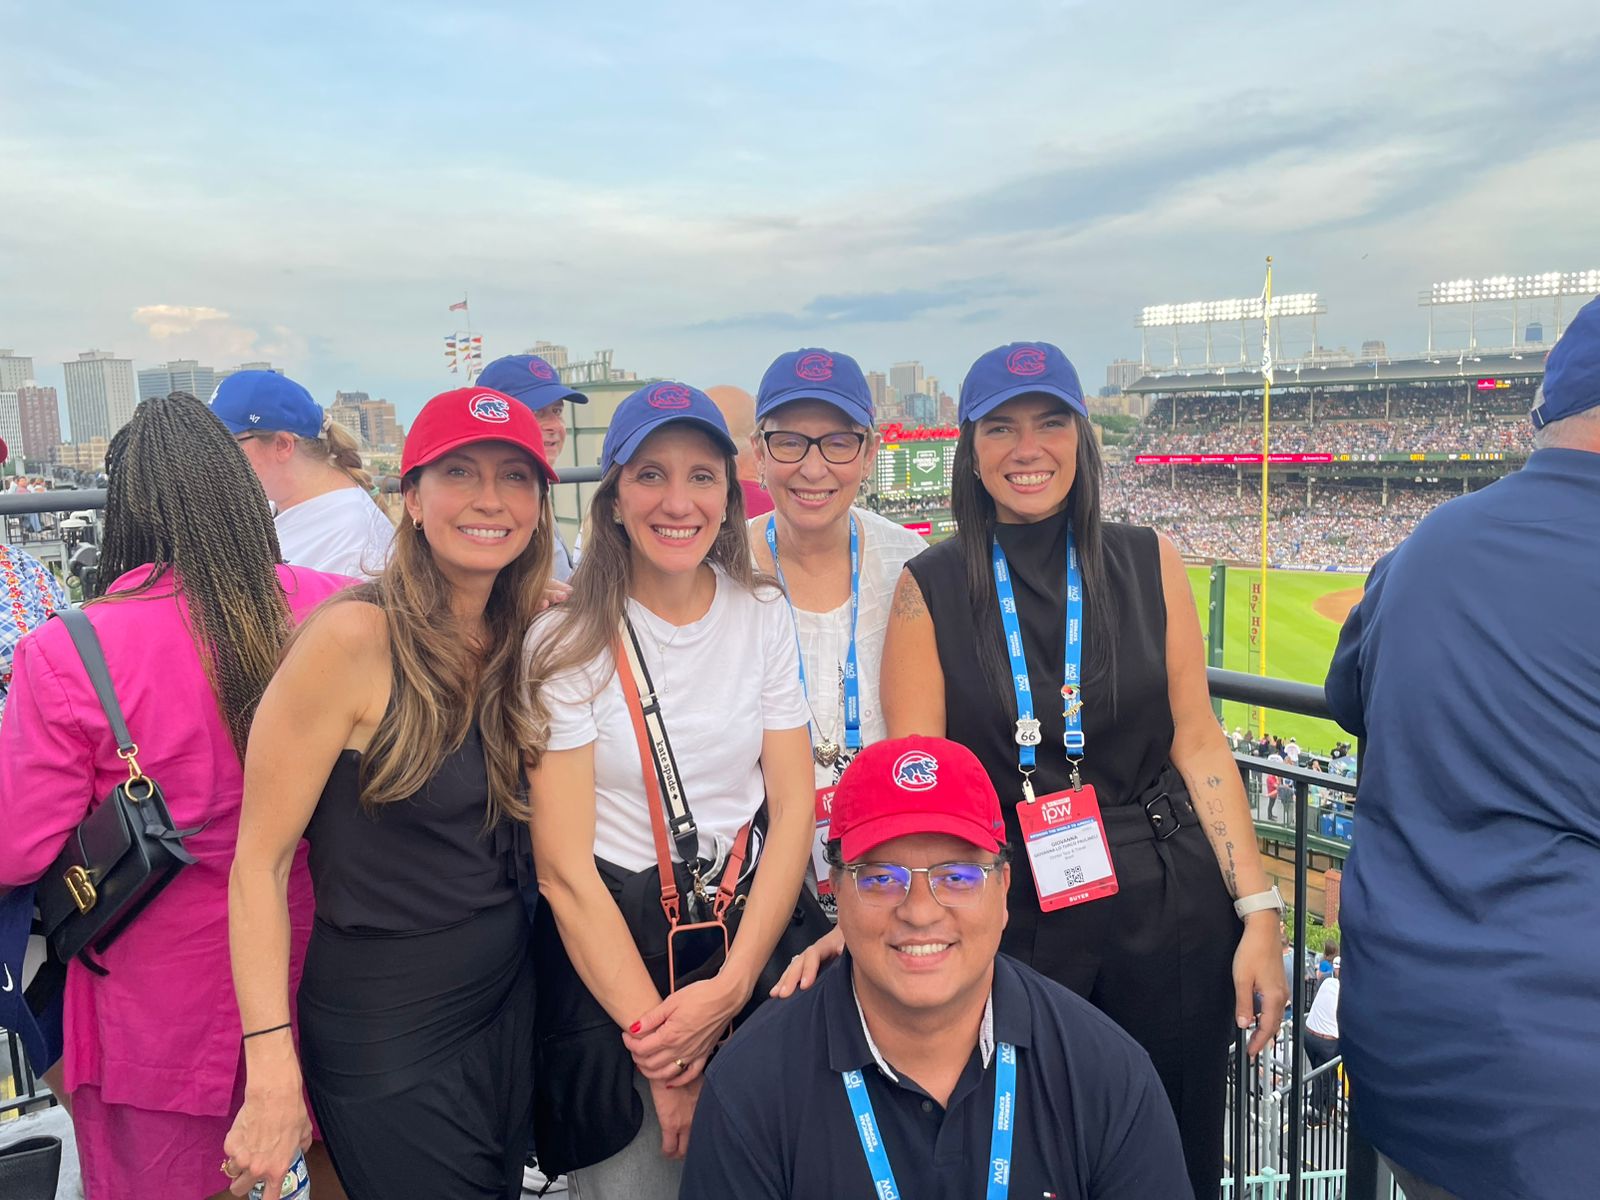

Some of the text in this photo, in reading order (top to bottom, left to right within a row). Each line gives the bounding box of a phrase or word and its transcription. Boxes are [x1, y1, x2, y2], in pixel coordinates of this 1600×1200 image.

[1021, 731, 1036, 741] 66
[656, 740, 677, 792] kate spade
[1041, 802, 1072, 825] ipw
[1051, 835, 1078, 847] GIOVANNA
[63, 865, 97, 915] B
[1069, 892, 1089, 902] BUYER
[1000, 1041, 1011, 1065] pw
[858, 1115, 874, 1152] AMERICAN
[864, 1112, 878, 1146] EXPRESS
[992, 1158, 1007, 1185] ipw
